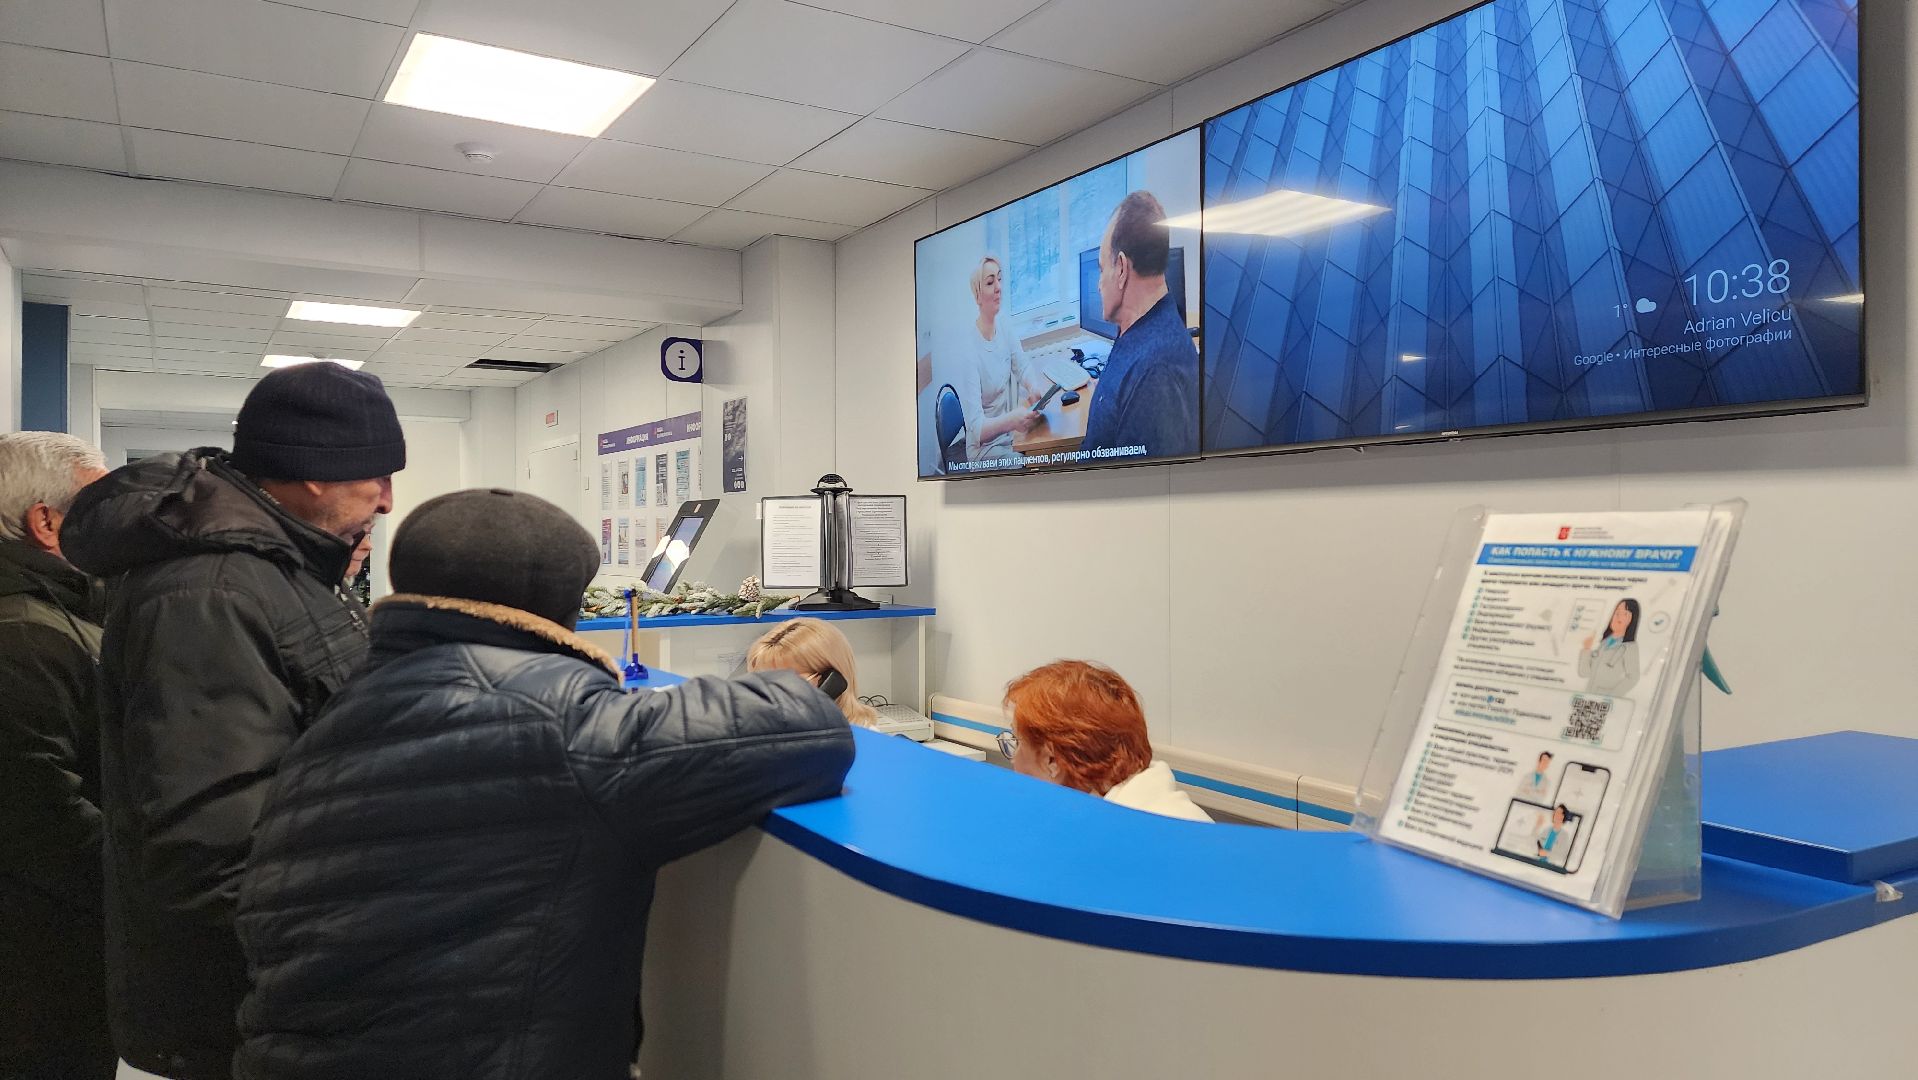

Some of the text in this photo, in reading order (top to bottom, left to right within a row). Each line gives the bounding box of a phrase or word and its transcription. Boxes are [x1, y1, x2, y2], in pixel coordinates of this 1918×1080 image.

[1684, 258, 1791, 306] 10:38
[1683, 308, 1792, 335] Adrian Velicu
[1574, 328, 1792, 366] Google Интересные фотографии
[1051, 451, 1091, 465] регулярно
[1091, 444, 1147, 459] обзваниваем,
[1491, 546, 1511, 556] КАК
[1513, 546, 1561, 557] ПОПАСТЬ
[1573, 548, 1634, 559] НУЖНОМУ
[1635, 549, 1684, 560] ВРАЧУ?
